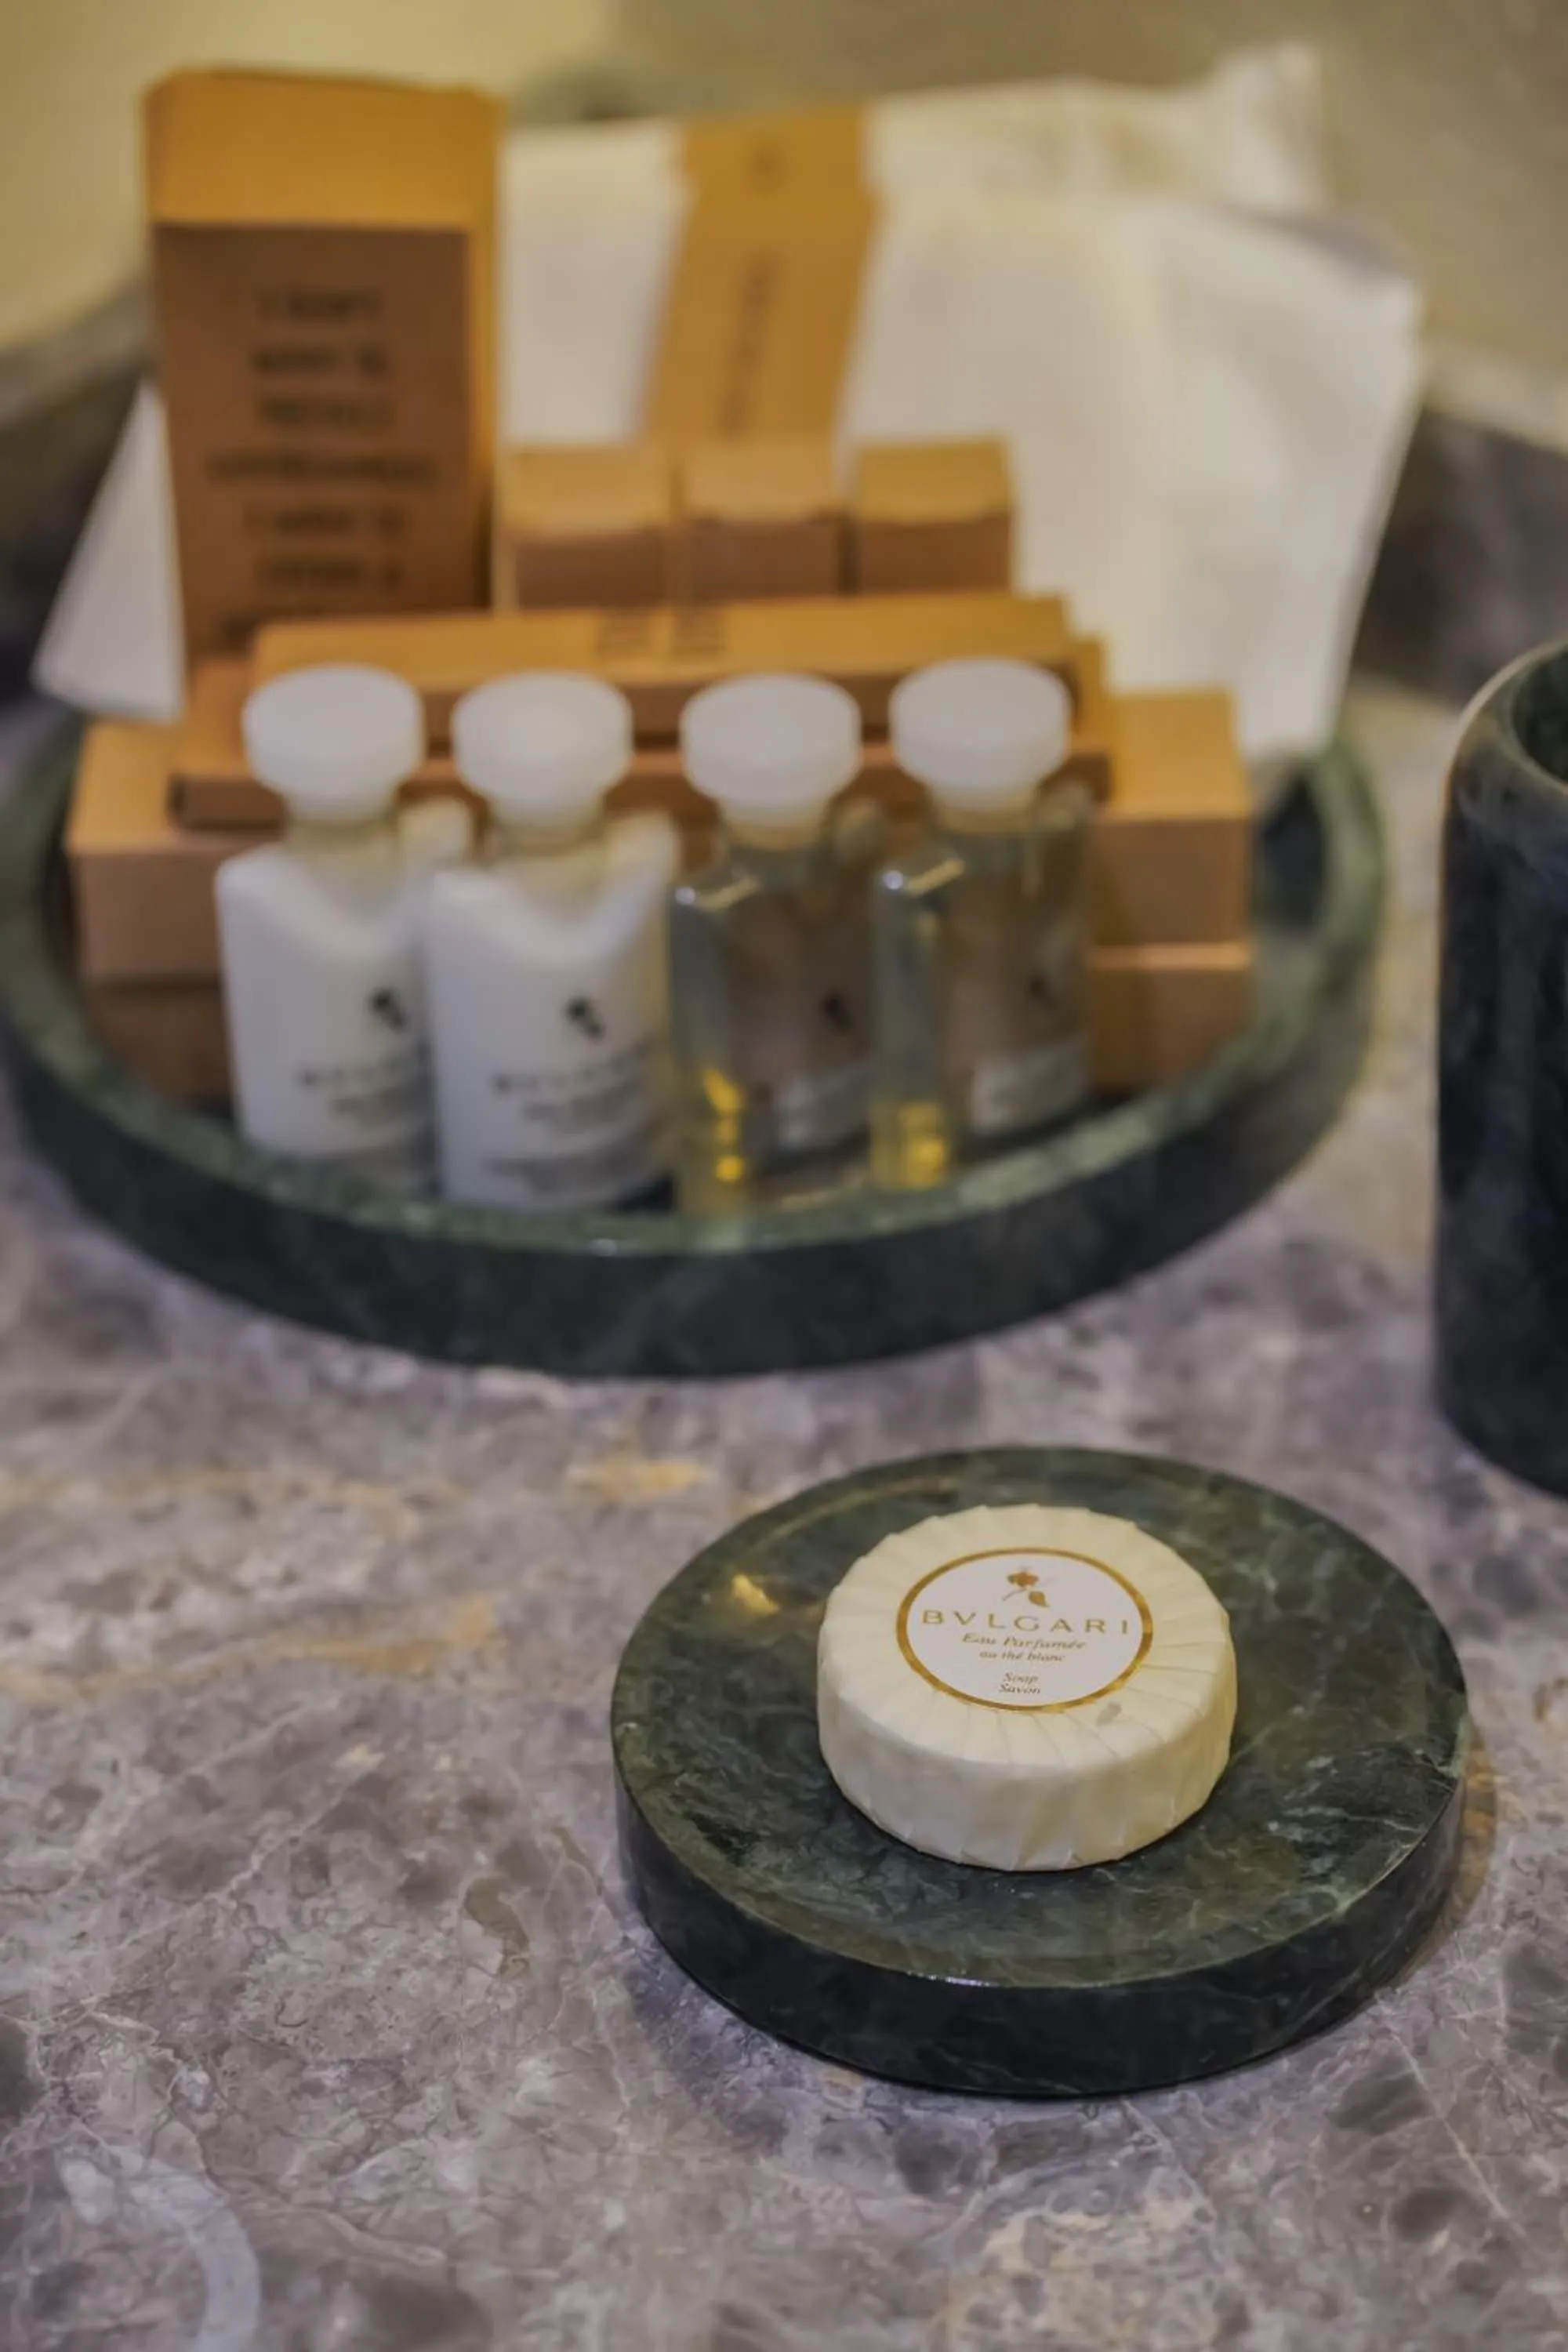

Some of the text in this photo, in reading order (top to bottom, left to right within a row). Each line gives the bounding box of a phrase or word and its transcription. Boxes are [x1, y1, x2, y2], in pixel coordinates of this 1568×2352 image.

[922, 1610, 1128, 1635] BVLGARI
[962, 1633, 996, 1645] Eau
[1026, 1651, 1065, 1662] blanc
[1003, 1672, 1039, 1684] Soap
[999, 1683, 1041, 1694] Savon
